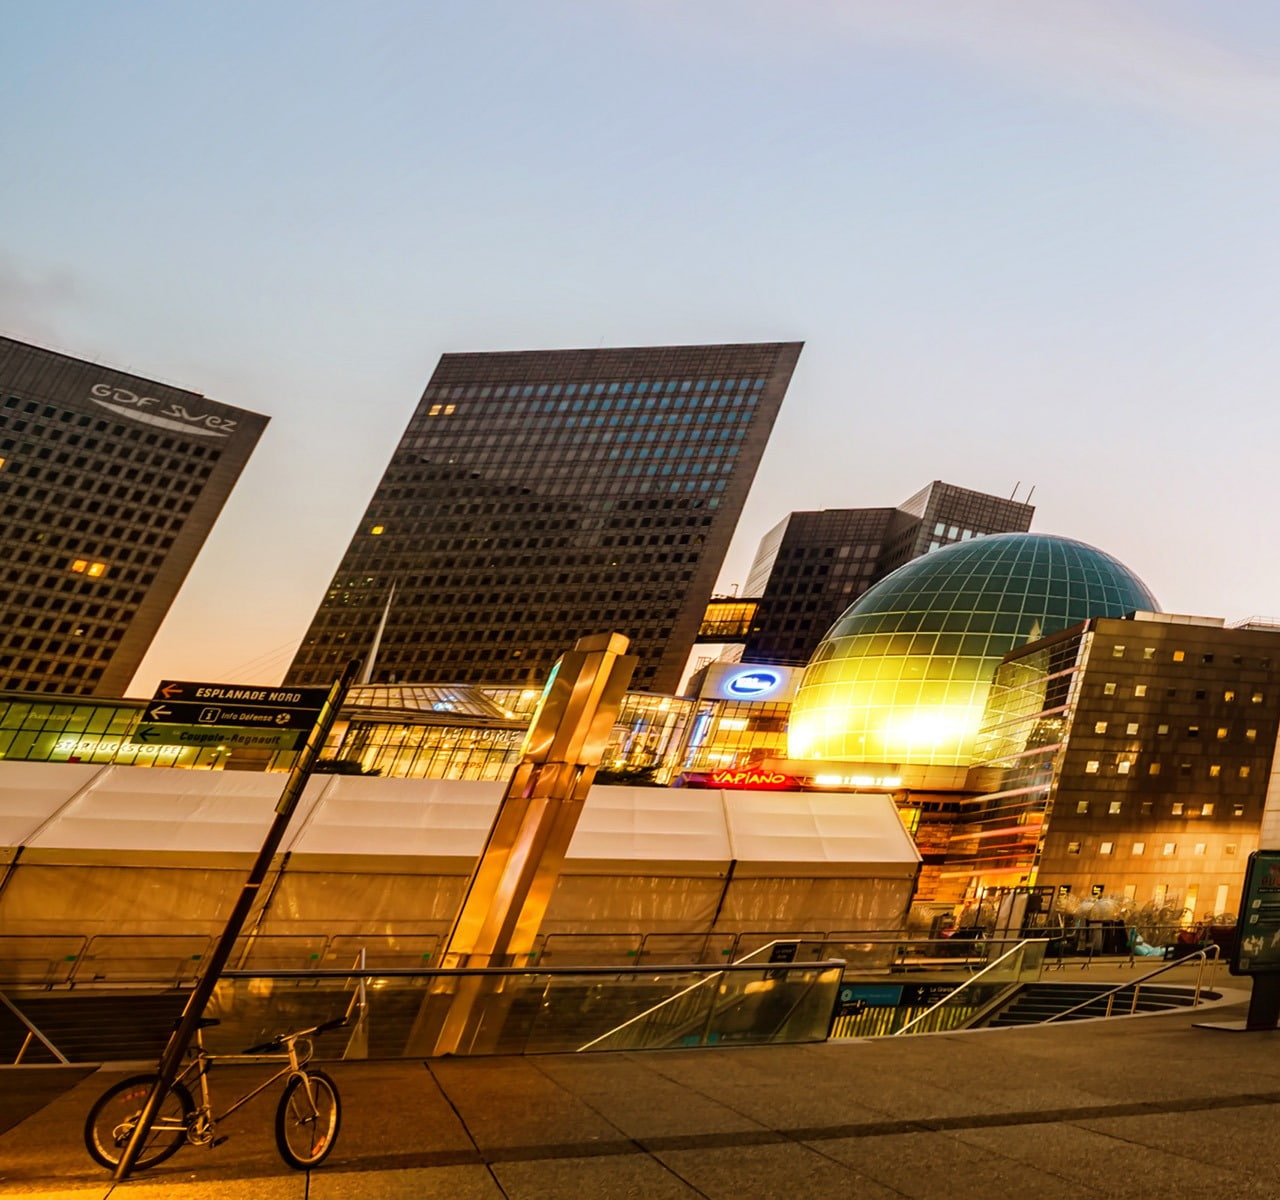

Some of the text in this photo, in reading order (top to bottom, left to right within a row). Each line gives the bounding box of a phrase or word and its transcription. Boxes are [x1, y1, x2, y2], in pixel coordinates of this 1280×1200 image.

[91, 383, 160, 407] GDF
[195, 687, 302, 703] ESPLANADE NORD
[221, 711, 238, 720] Info
